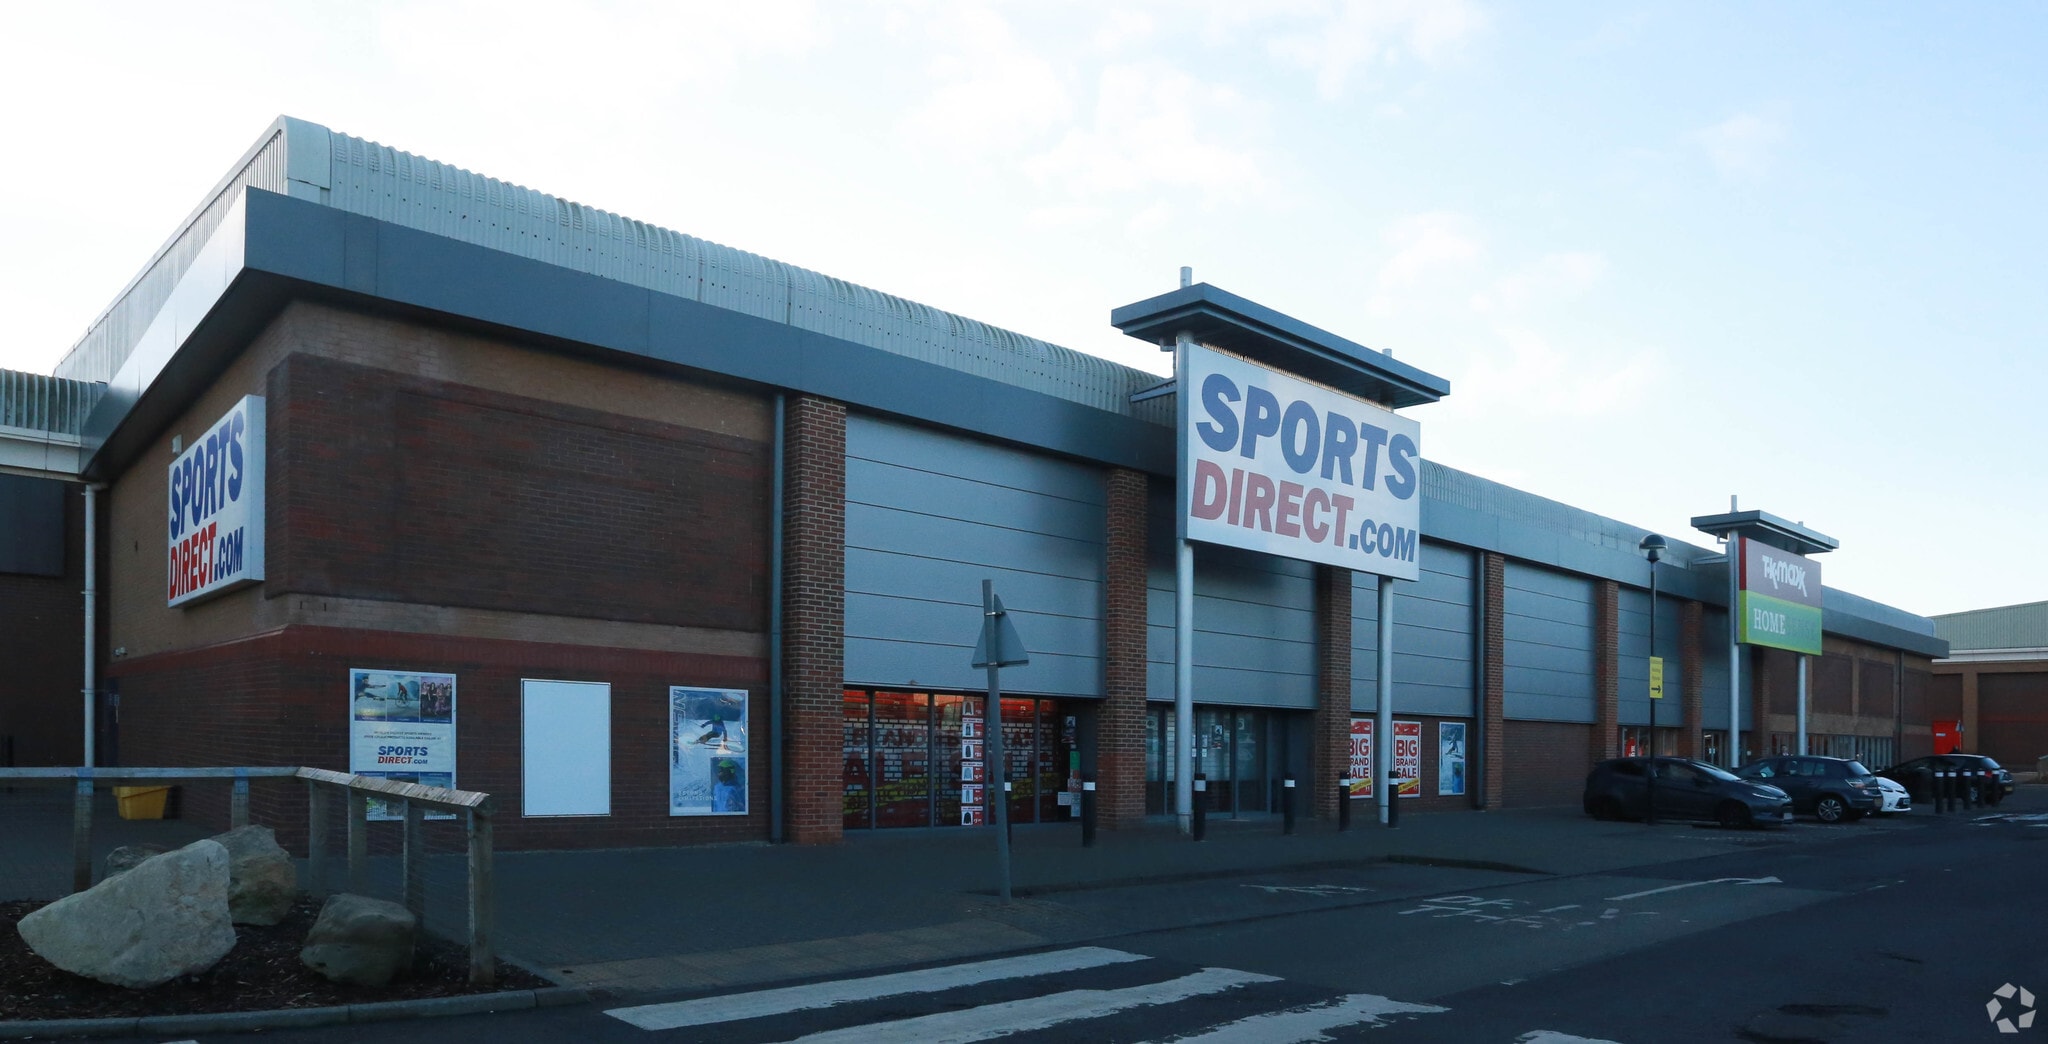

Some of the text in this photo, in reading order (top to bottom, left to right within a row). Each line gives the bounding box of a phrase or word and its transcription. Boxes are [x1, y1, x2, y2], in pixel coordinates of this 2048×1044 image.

[1196, 373, 1417, 500] SPORTS
[170, 410, 244, 540] SPORTS
[378, 745, 428, 756] SPORTS
[1396, 740, 1417, 757] BIG
[1350, 758, 1369, 766] RAND
[1396, 758, 1417, 767] BRAND
[1349, 768, 1369, 778] ALE
